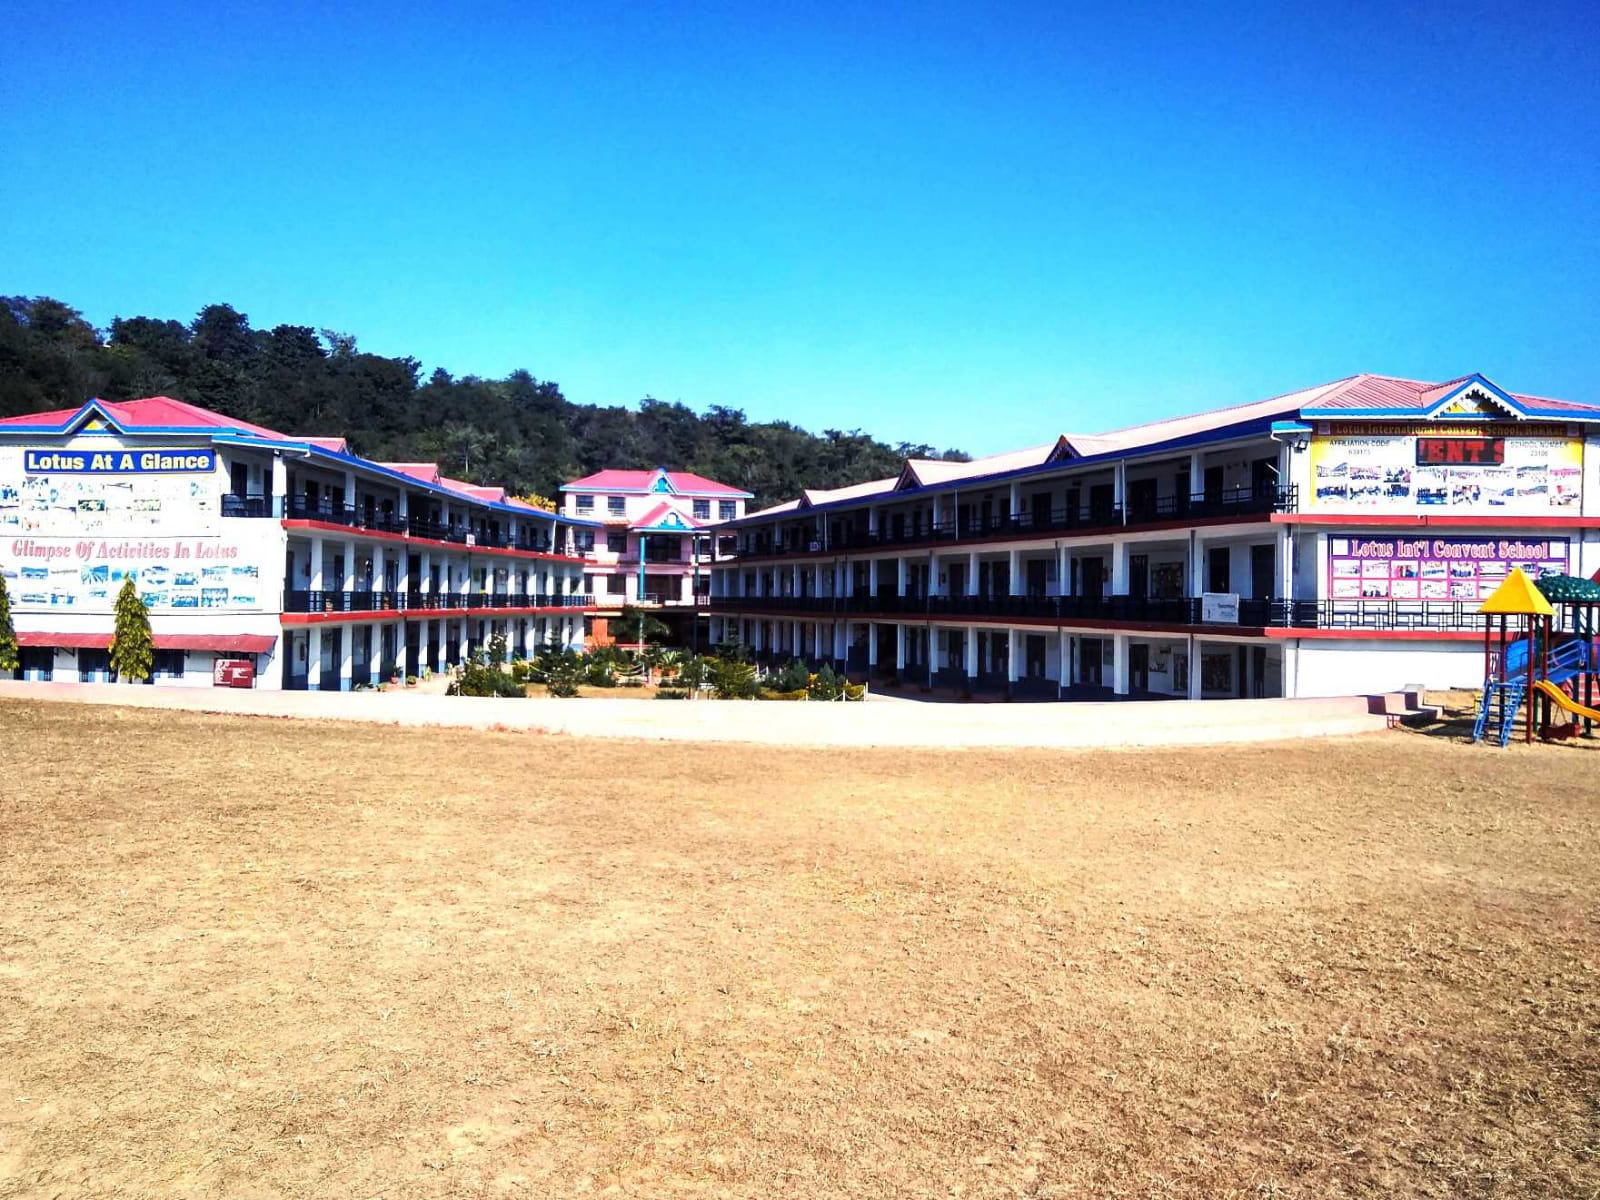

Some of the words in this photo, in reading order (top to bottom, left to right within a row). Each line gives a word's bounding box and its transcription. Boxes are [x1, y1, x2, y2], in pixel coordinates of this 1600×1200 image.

[1335, 423, 1365, 435] Lotus
[28, 453, 85, 470] Lotus
[90, 453, 114, 470] At
[119, 454, 135, 470] A
[140, 453, 210, 470] Glance
[11, 539, 71, 562] Glimpse
[75, 541, 96, 562] Of
[96, 541, 170, 559] Activities
[173, 541, 190, 559] In
[195, 541, 238, 559] Lotus
[1351, 540, 1394, 558] Lotus
[1433, 540, 1496, 559] Convent
[1498, 540, 1549, 560] School
